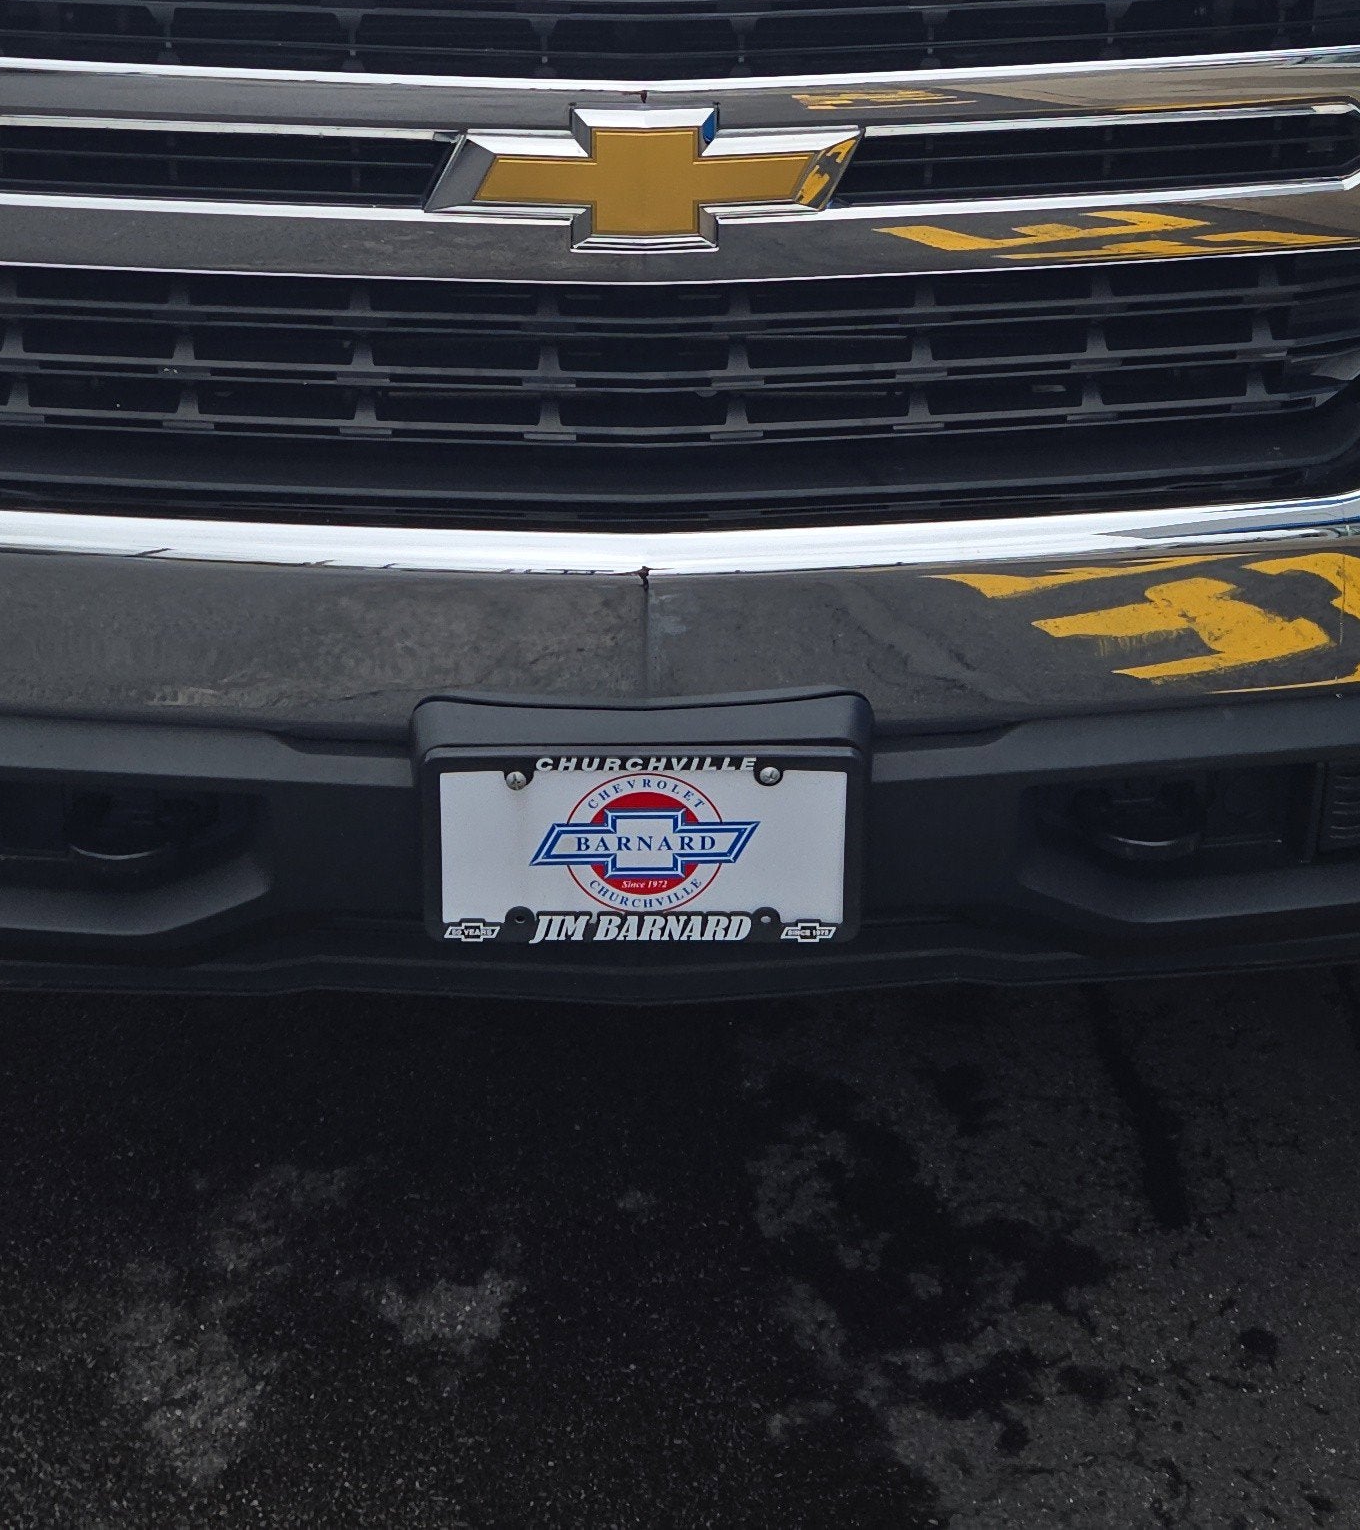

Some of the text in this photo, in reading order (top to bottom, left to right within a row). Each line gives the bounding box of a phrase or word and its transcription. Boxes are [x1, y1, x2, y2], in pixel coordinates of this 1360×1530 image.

[535, 756, 757, 772] CHURCHVILLE
[587, 778, 706, 810] CHEVROLET
[575, 835, 716, 851] BARNARD
[589, 878, 702, 908] CHURCHVILLE
[621, 880, 668, 889] Since 1972
[528, 915, 752, 944] JIM BARNARD
